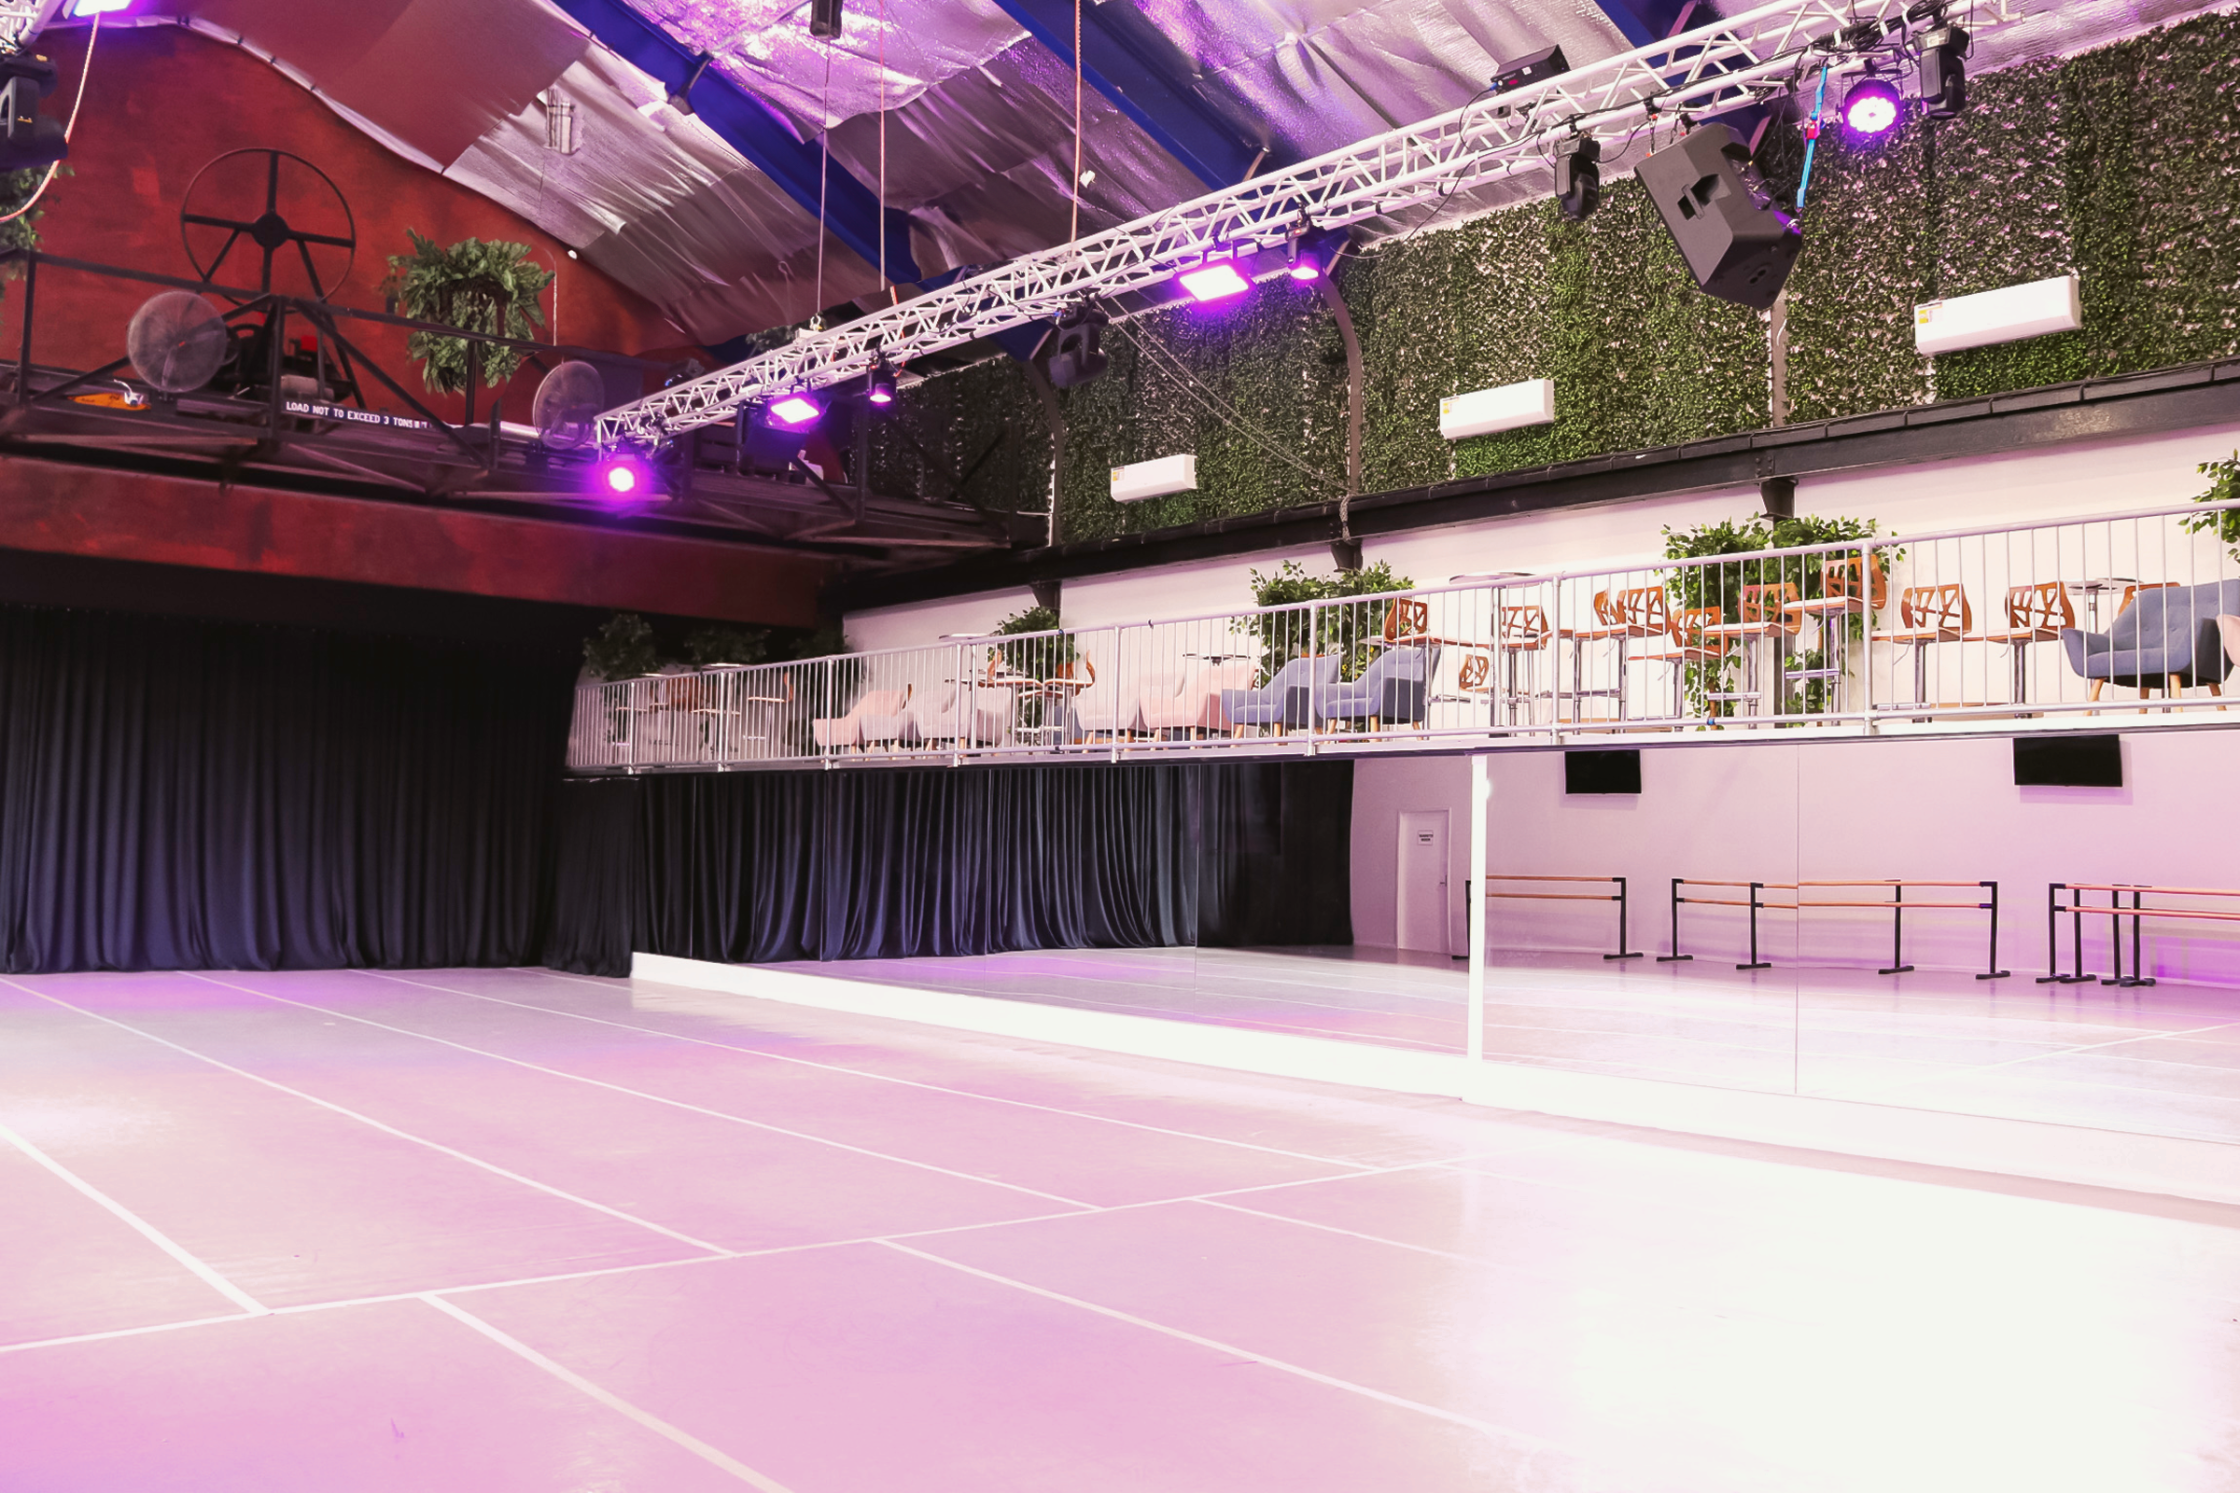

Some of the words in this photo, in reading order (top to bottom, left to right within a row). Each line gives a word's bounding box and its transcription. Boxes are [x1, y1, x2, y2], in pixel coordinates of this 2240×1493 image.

[286, 401, 310, 413] LOAD
[312, 405, 329, 416] NOT
[333, 408, 345, 418] TO
[347, 410, 381, 424] EXCEED
[383, 415, 390, 425] 3
[392, 416, 413, 428] TONS
